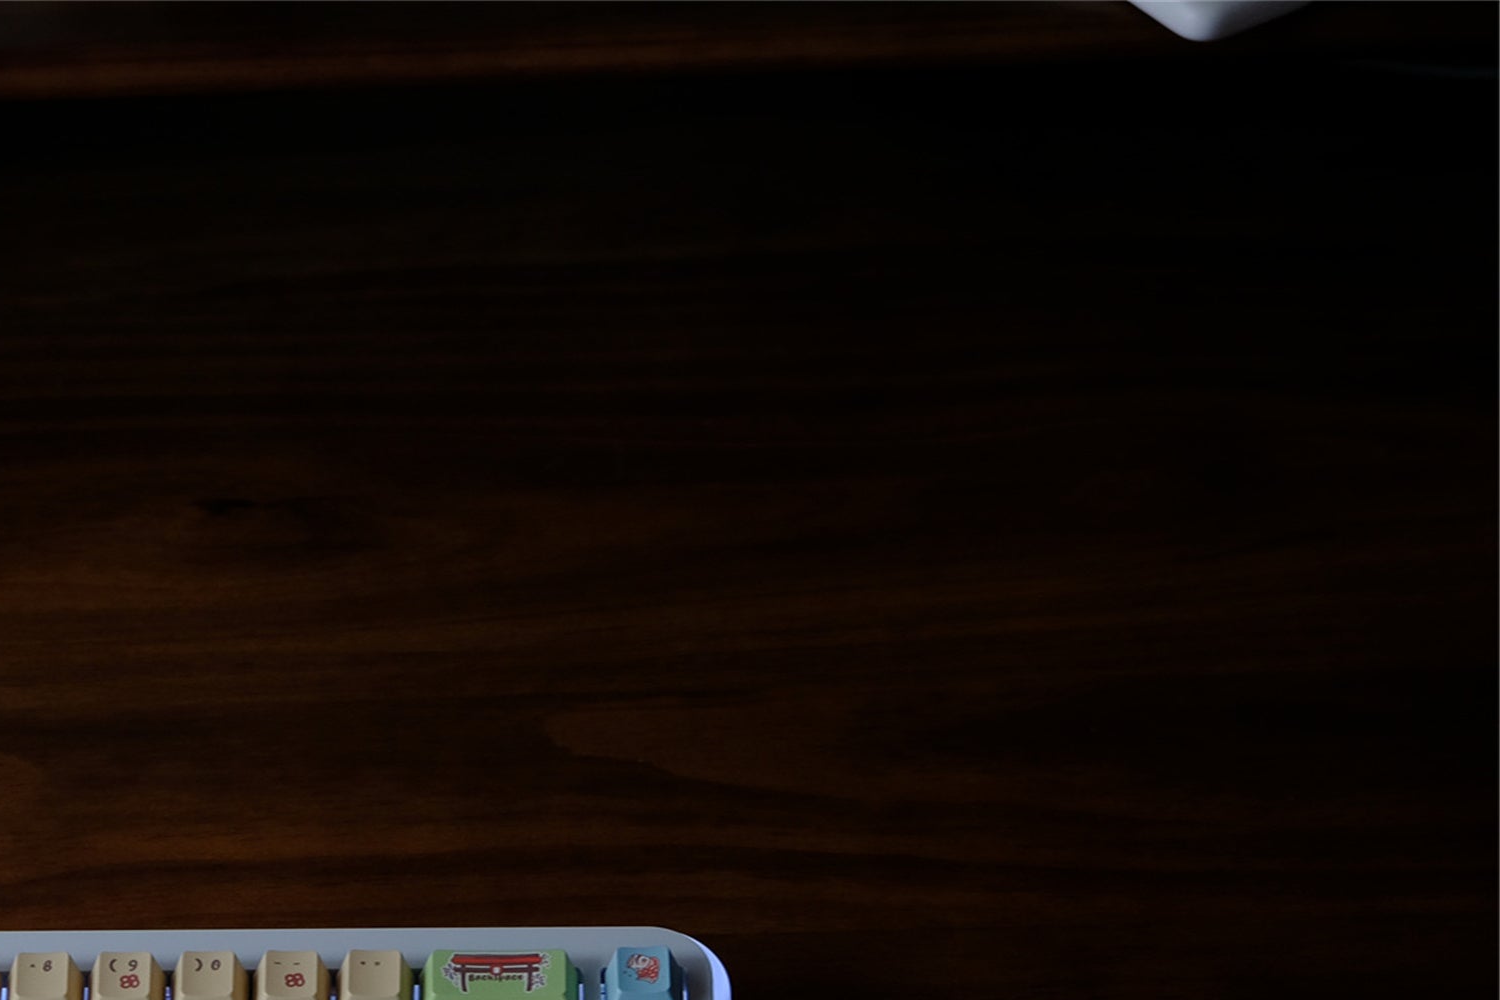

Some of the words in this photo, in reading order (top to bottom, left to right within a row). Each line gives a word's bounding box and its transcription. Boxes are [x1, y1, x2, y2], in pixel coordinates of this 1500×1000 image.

[42, 959, 53, 973] 8
[127, 959, 138, 972] 9
[210, 959, 222, 971] 0
